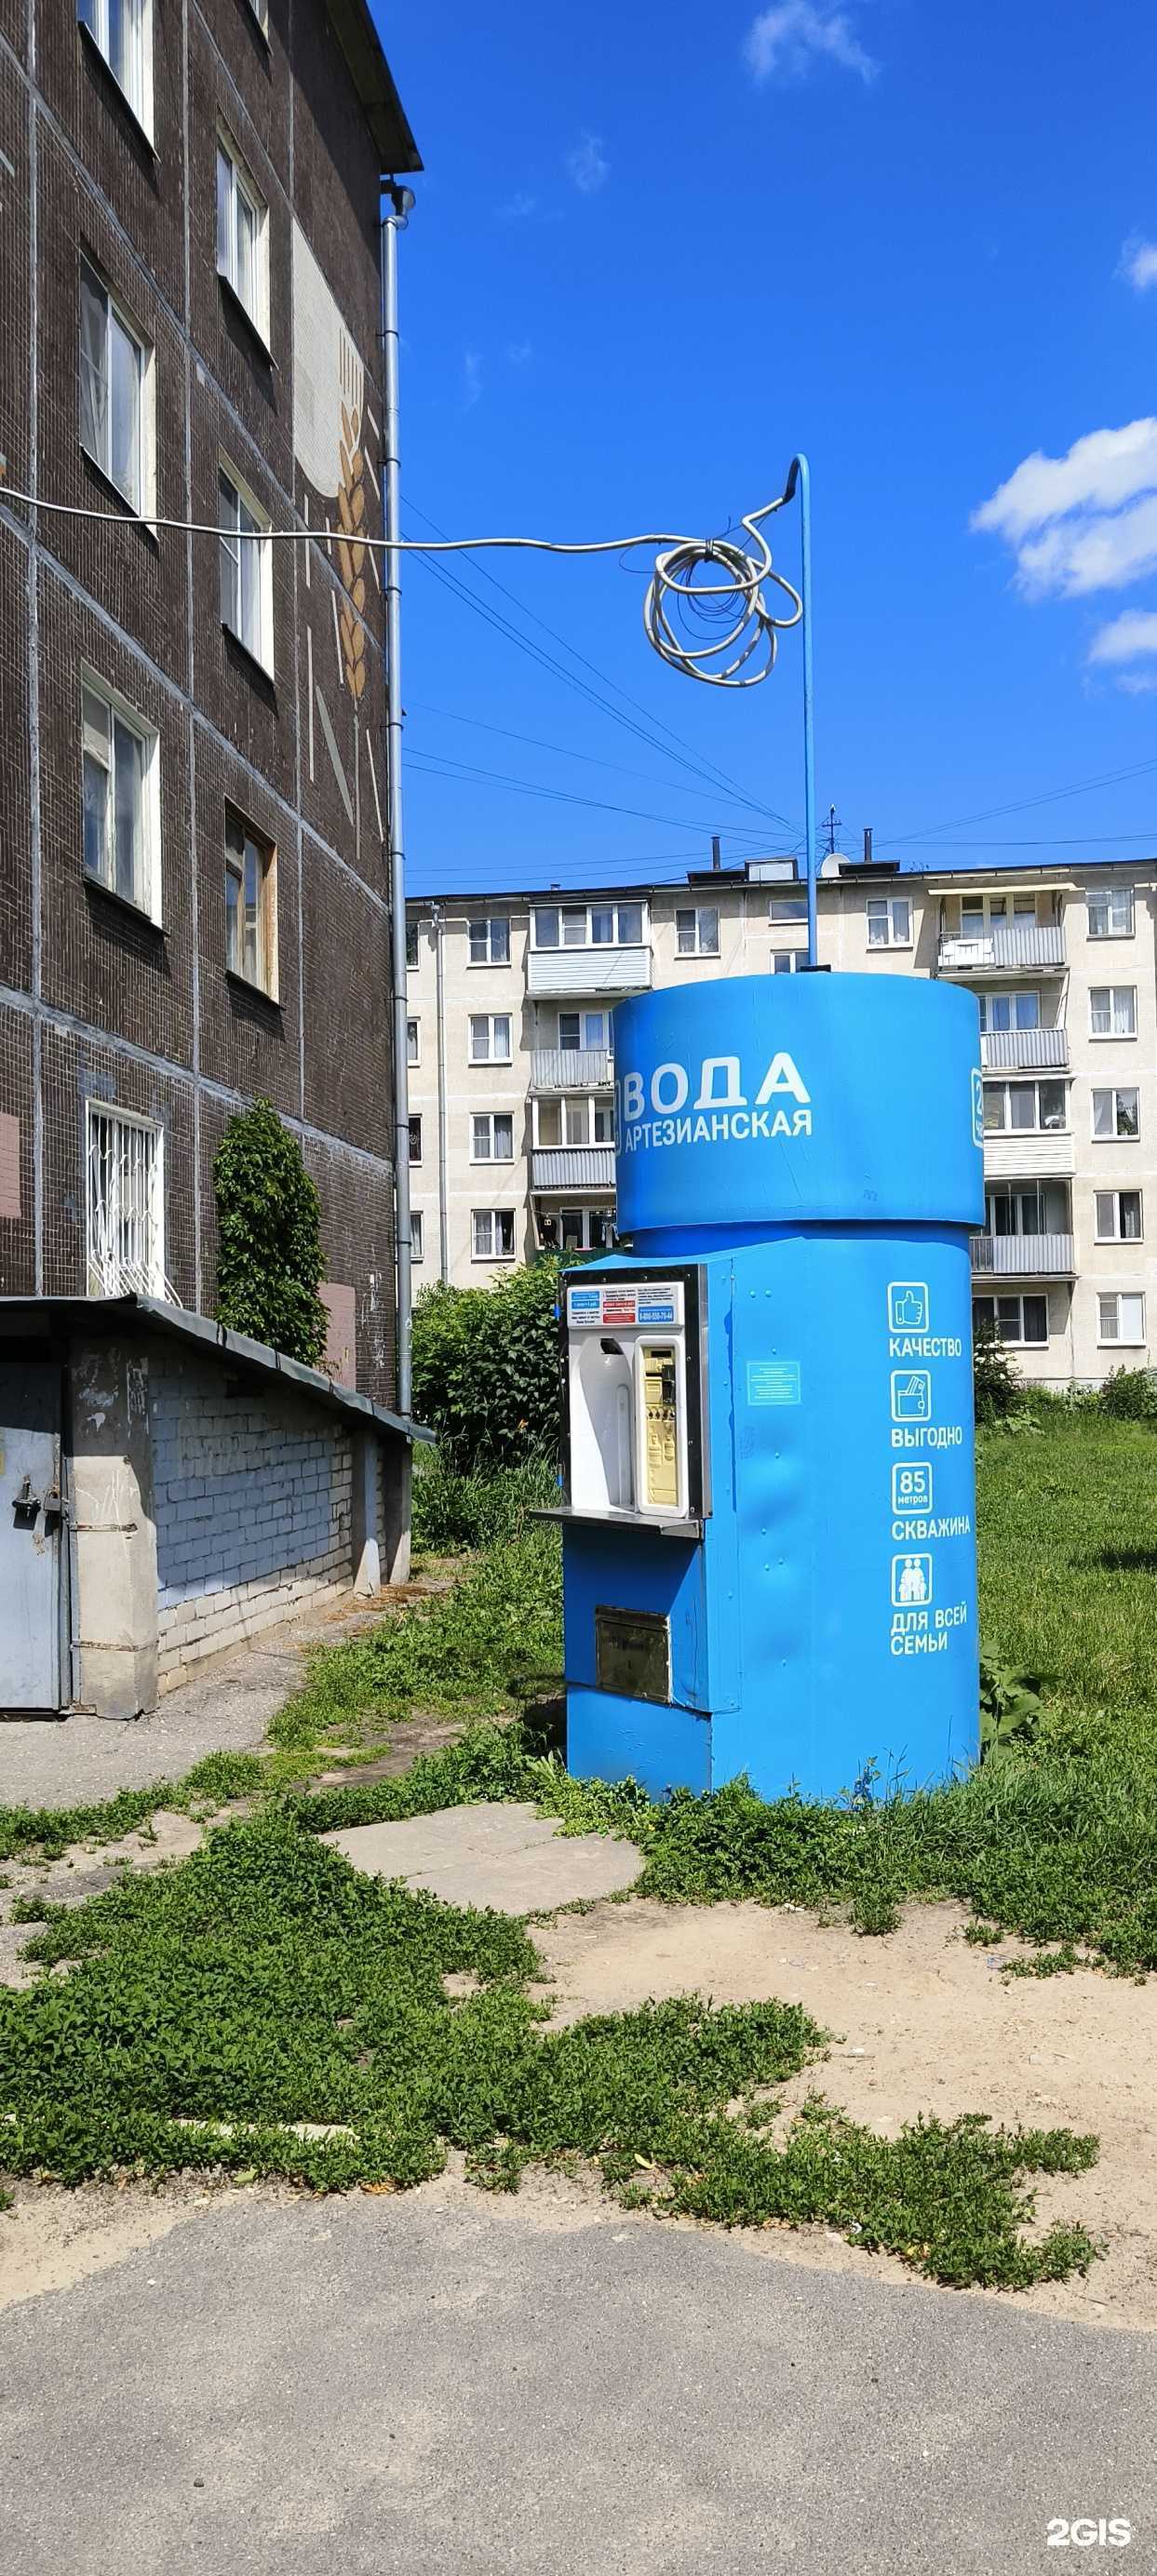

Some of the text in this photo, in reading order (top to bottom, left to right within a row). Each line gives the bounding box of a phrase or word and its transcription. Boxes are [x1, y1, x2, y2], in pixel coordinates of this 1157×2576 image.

[624, 1052, 812, 1122] ВОДА
[625, 1108, 813, 1154] АРТЕЗИАНСКАЯ
[889, 1337, 962, 1358] КАЧЕСТВО
[891, 1426, 962, 1450] ВЫГОДНО
[899, 1470, 926, 1494] 85
[897, 1494, 929, 1506] метров
[891, 1514, 971, 1541] СКВАЖИНА
[890, 1600, 968, 1637] ДЛЯ ВСЕЙ
[890, 1630, 948, 1657] СЕМЬИ
